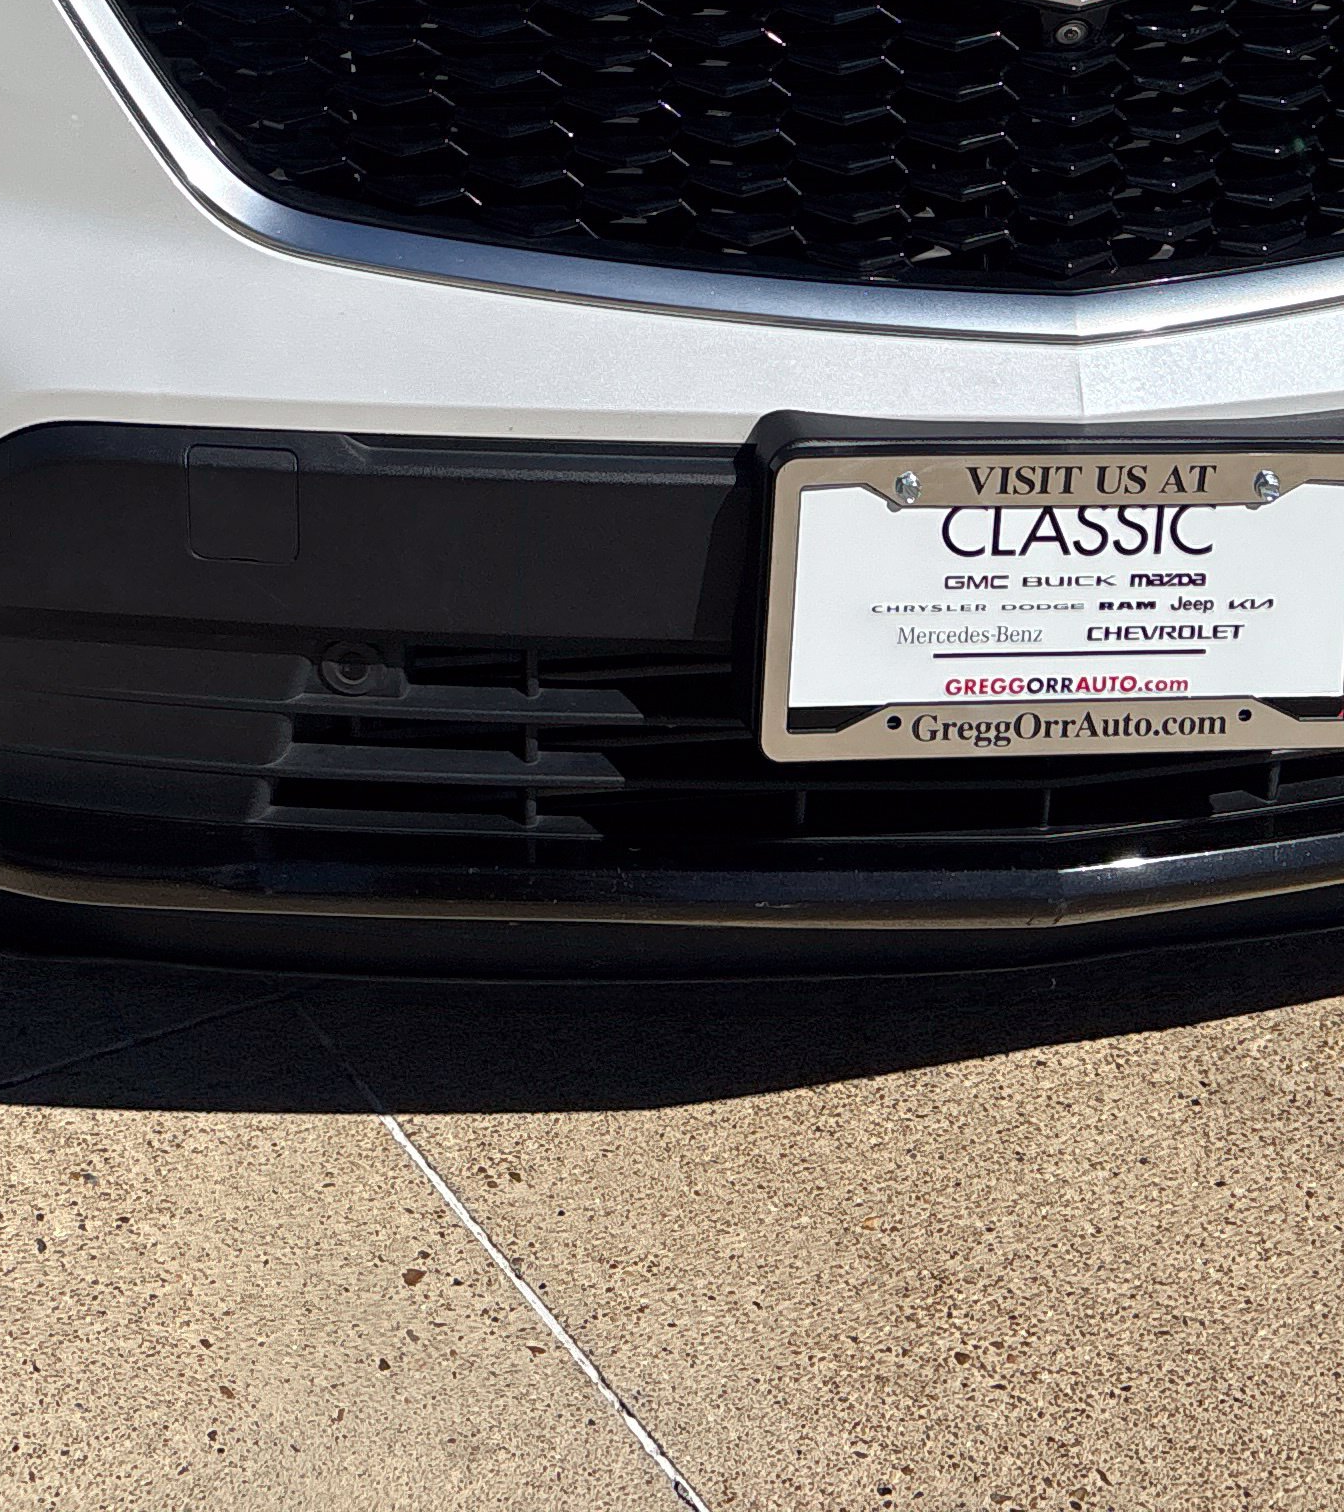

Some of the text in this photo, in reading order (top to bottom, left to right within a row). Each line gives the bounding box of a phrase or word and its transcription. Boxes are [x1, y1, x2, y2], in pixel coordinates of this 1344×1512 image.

[965, 464, 1217, 495] VISIT US AT
[941, 505, 1216, 557] CLASSIC
[944, 574, 1009, 590] GMC
[1021, 574, 1117, 588] BUICK
[871, 603, 987, 614] CHRYSLER
[1001, 602, 1085, 612] DODGE
[1098, 600, 1157, 611] RAM
[1170, 596, 1215, 614] Jeep
[896, 624, 1245, 645] Mercedes-Benz CHEVROLET
[944, 675, 1189, 696] GREGGORRAUTO.com
[911, 710, 1227, 748] GreggOrrAuto.com
